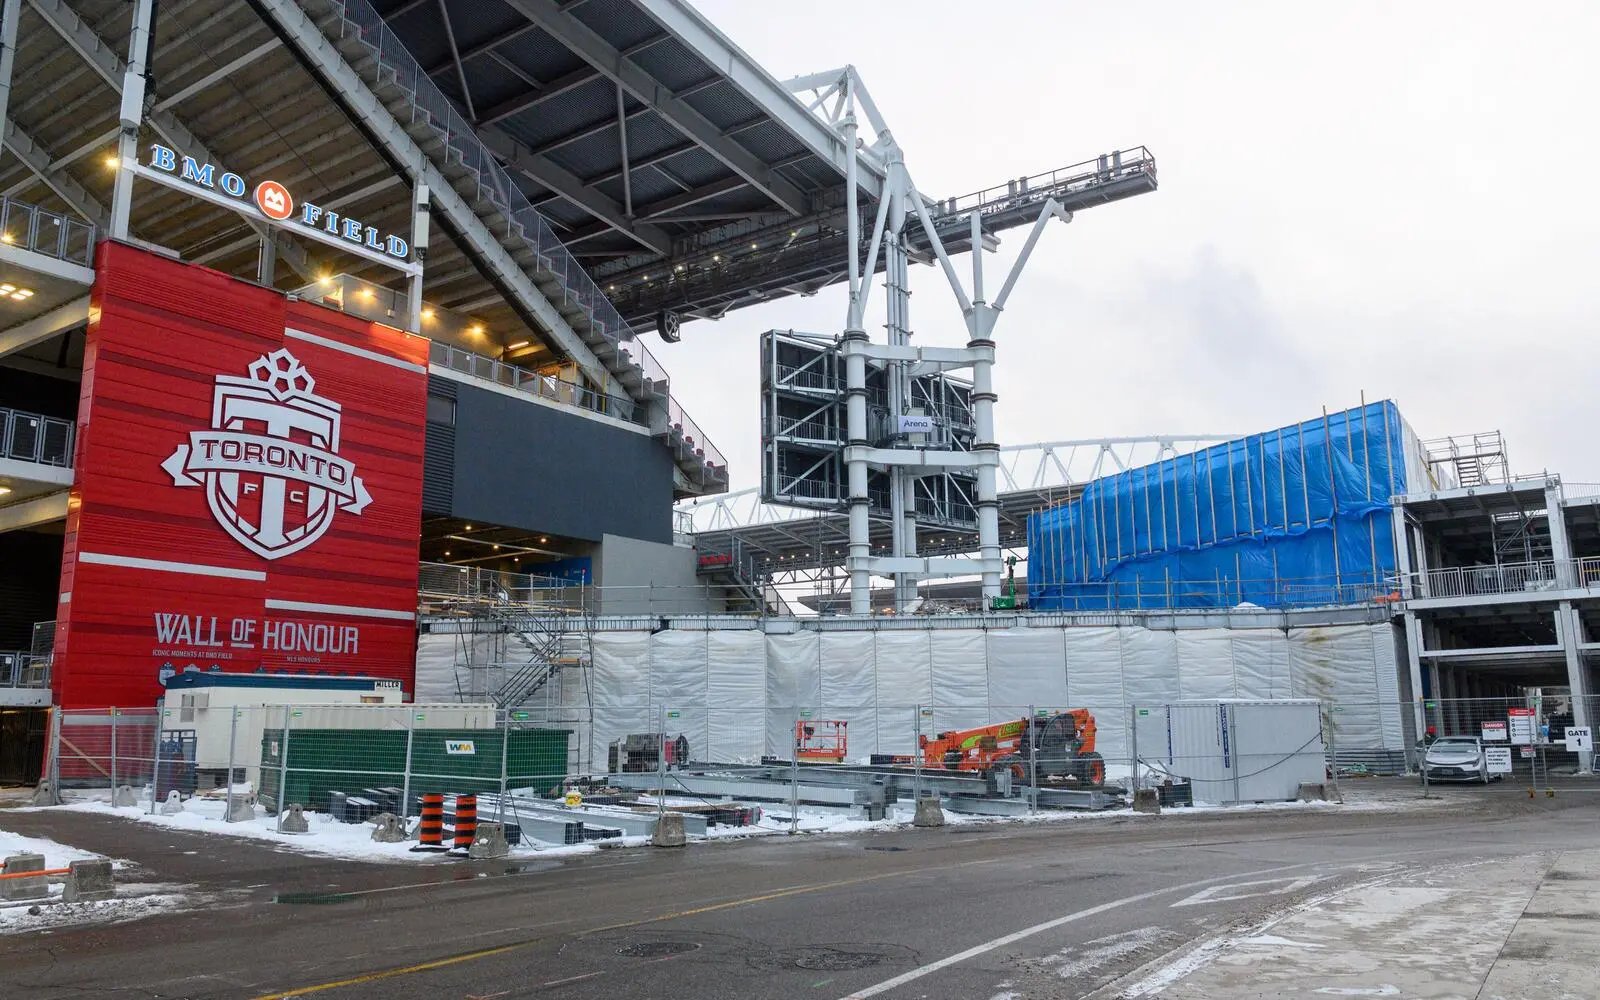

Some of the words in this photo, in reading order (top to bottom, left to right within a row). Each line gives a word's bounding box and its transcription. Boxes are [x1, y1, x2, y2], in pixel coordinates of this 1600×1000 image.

[151, 144, 245, 196] BMO
[301, 202, 408, 258] FIELD
[199, 439, 347, 485] TORONTO
[154, 612, 223, 647] WALL
[230, 618, 256, 645] OF
[262, 621, 359, 654] HONOUR
[1577, 738, 1581, 746] 1
